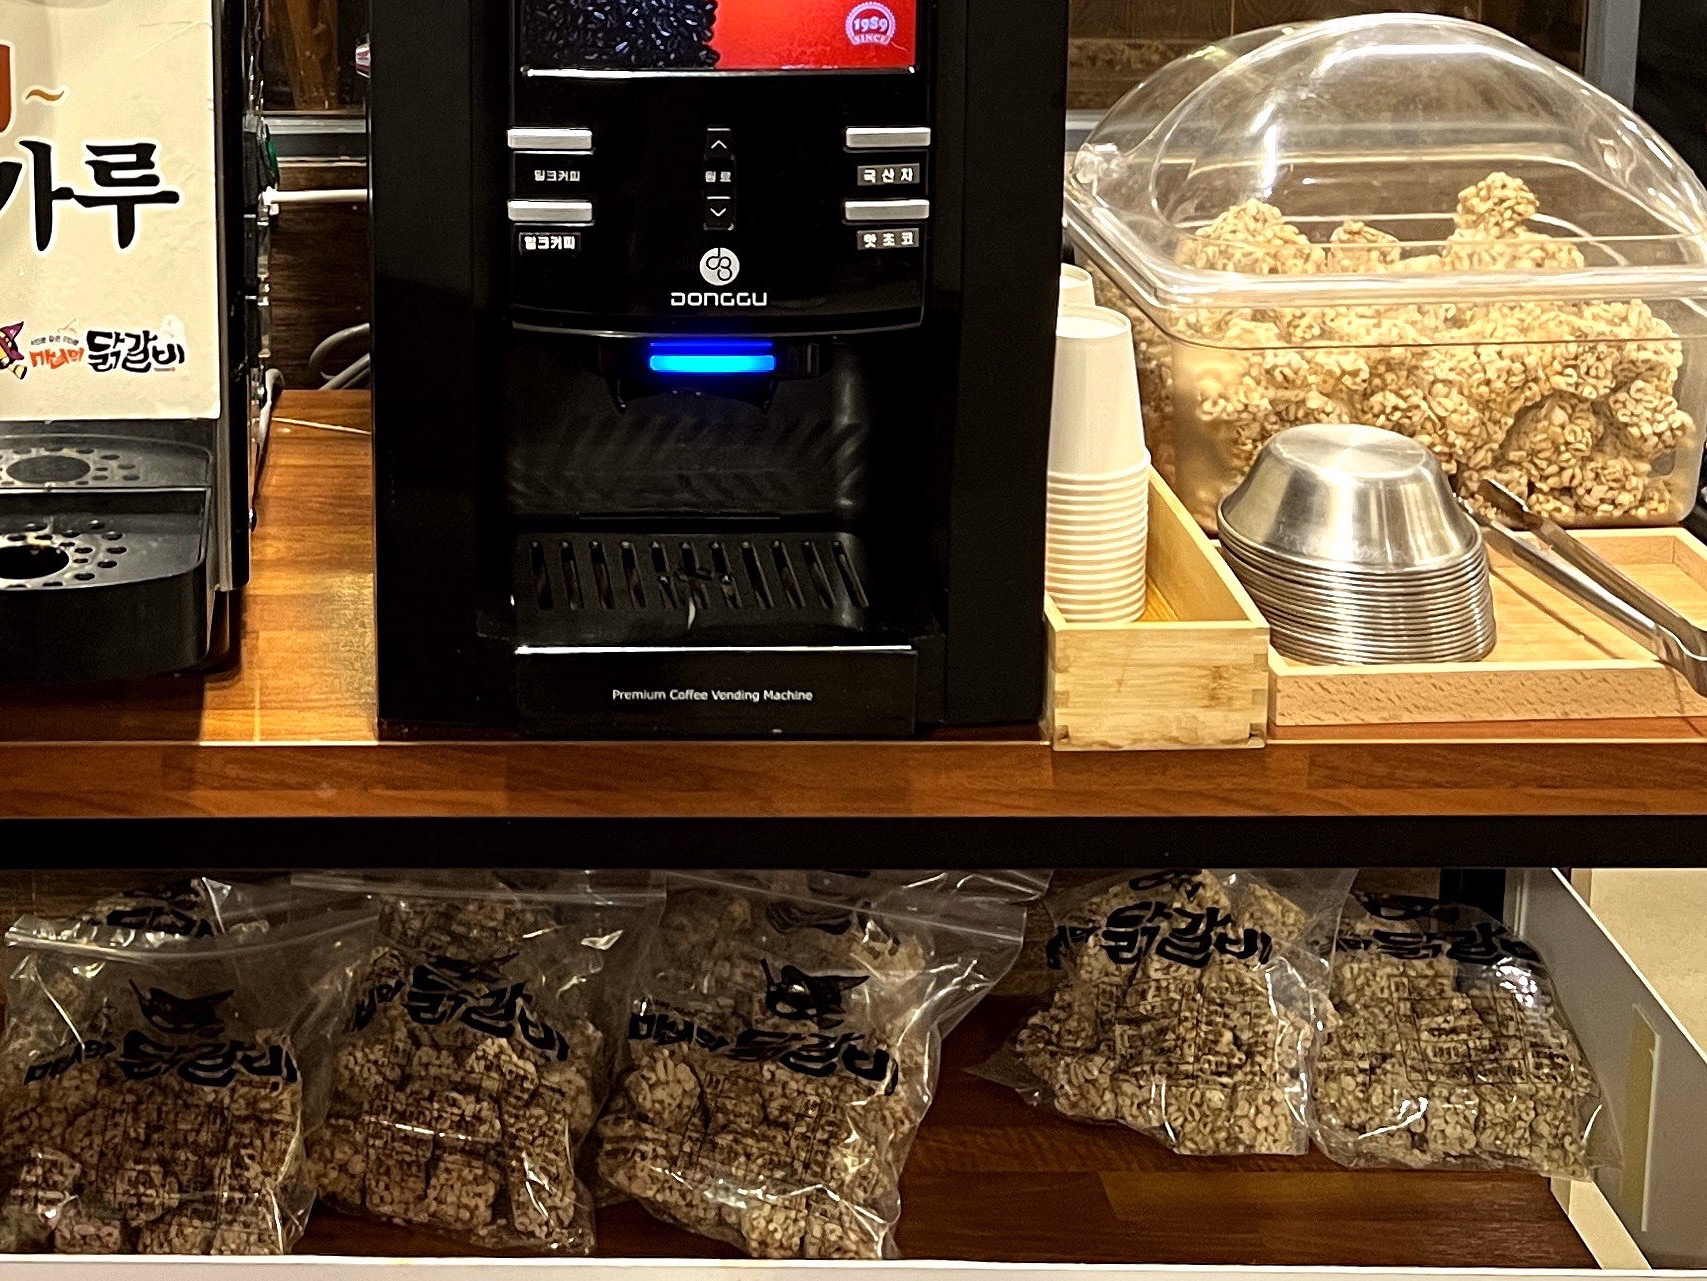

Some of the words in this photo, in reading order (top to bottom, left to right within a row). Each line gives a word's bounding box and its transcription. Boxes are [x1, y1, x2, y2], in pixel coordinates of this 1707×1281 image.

[670, 292, 767, 307] DONGGU
[86, 330, 185, 373] 닭갈비
[612, 689, 666, 701] Premium
[669, 689, 708, 701] Coffee
[711, 689, 760, 703] Vending
[763, 689, 813, 701] Machine
